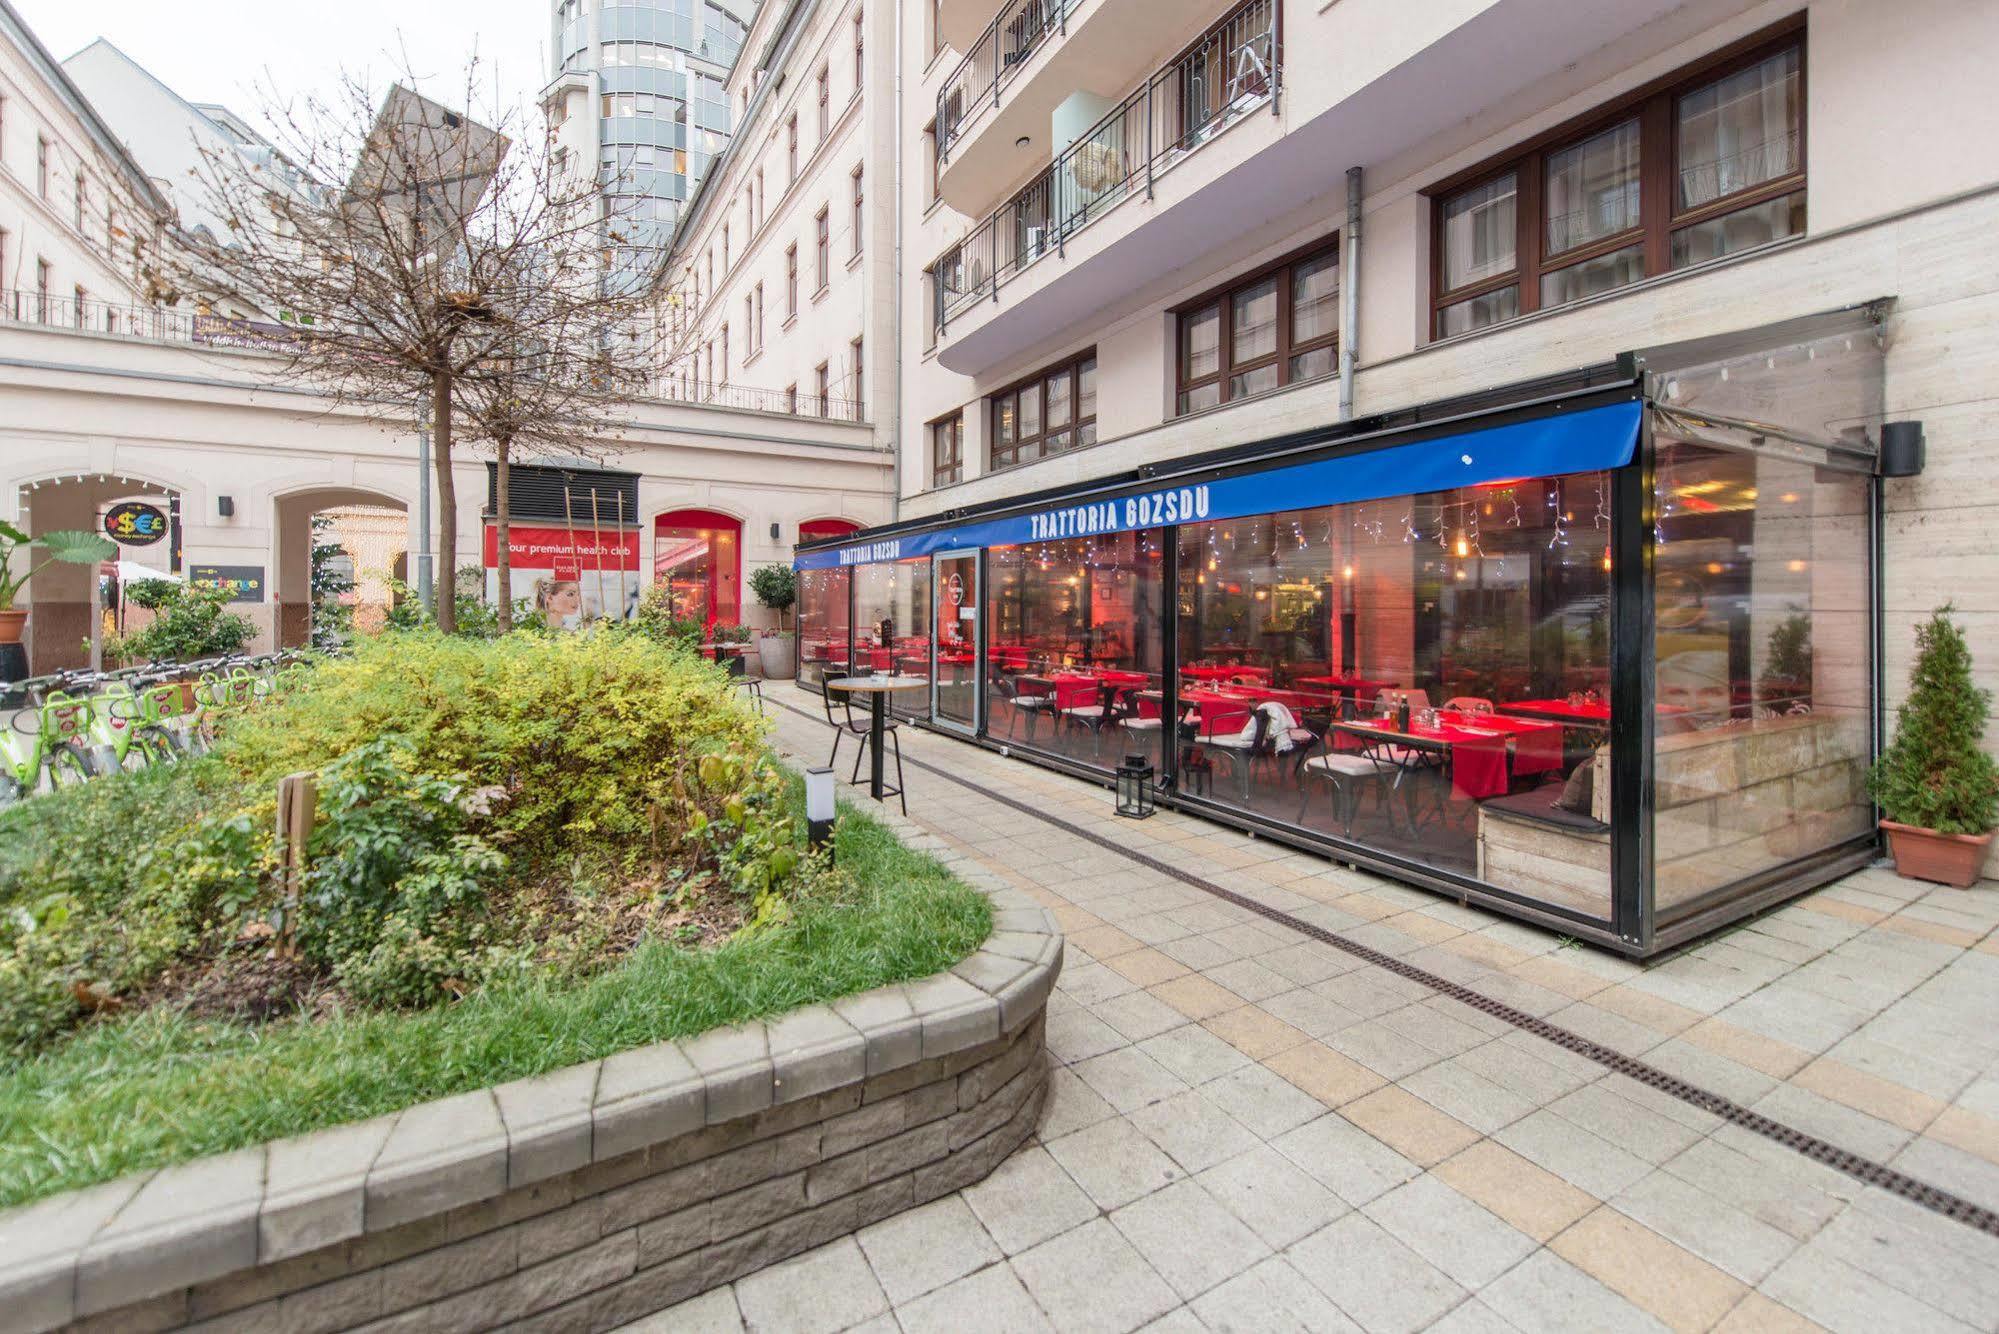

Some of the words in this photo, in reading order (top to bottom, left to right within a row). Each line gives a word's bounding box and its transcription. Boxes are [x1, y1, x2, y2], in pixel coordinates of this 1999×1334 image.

[1031, 502, 1117, 540] TRATTORIA
[1126, 485, 1209, 528] GOZSDU
[508, 541, 527, 552] our
[530, 543, 574, 555] premium
[840, 545, 871, 566] TRATTORIA
[873, 540, 900, 561] GOZSDU
[196, 576, 258, 592] exchange
